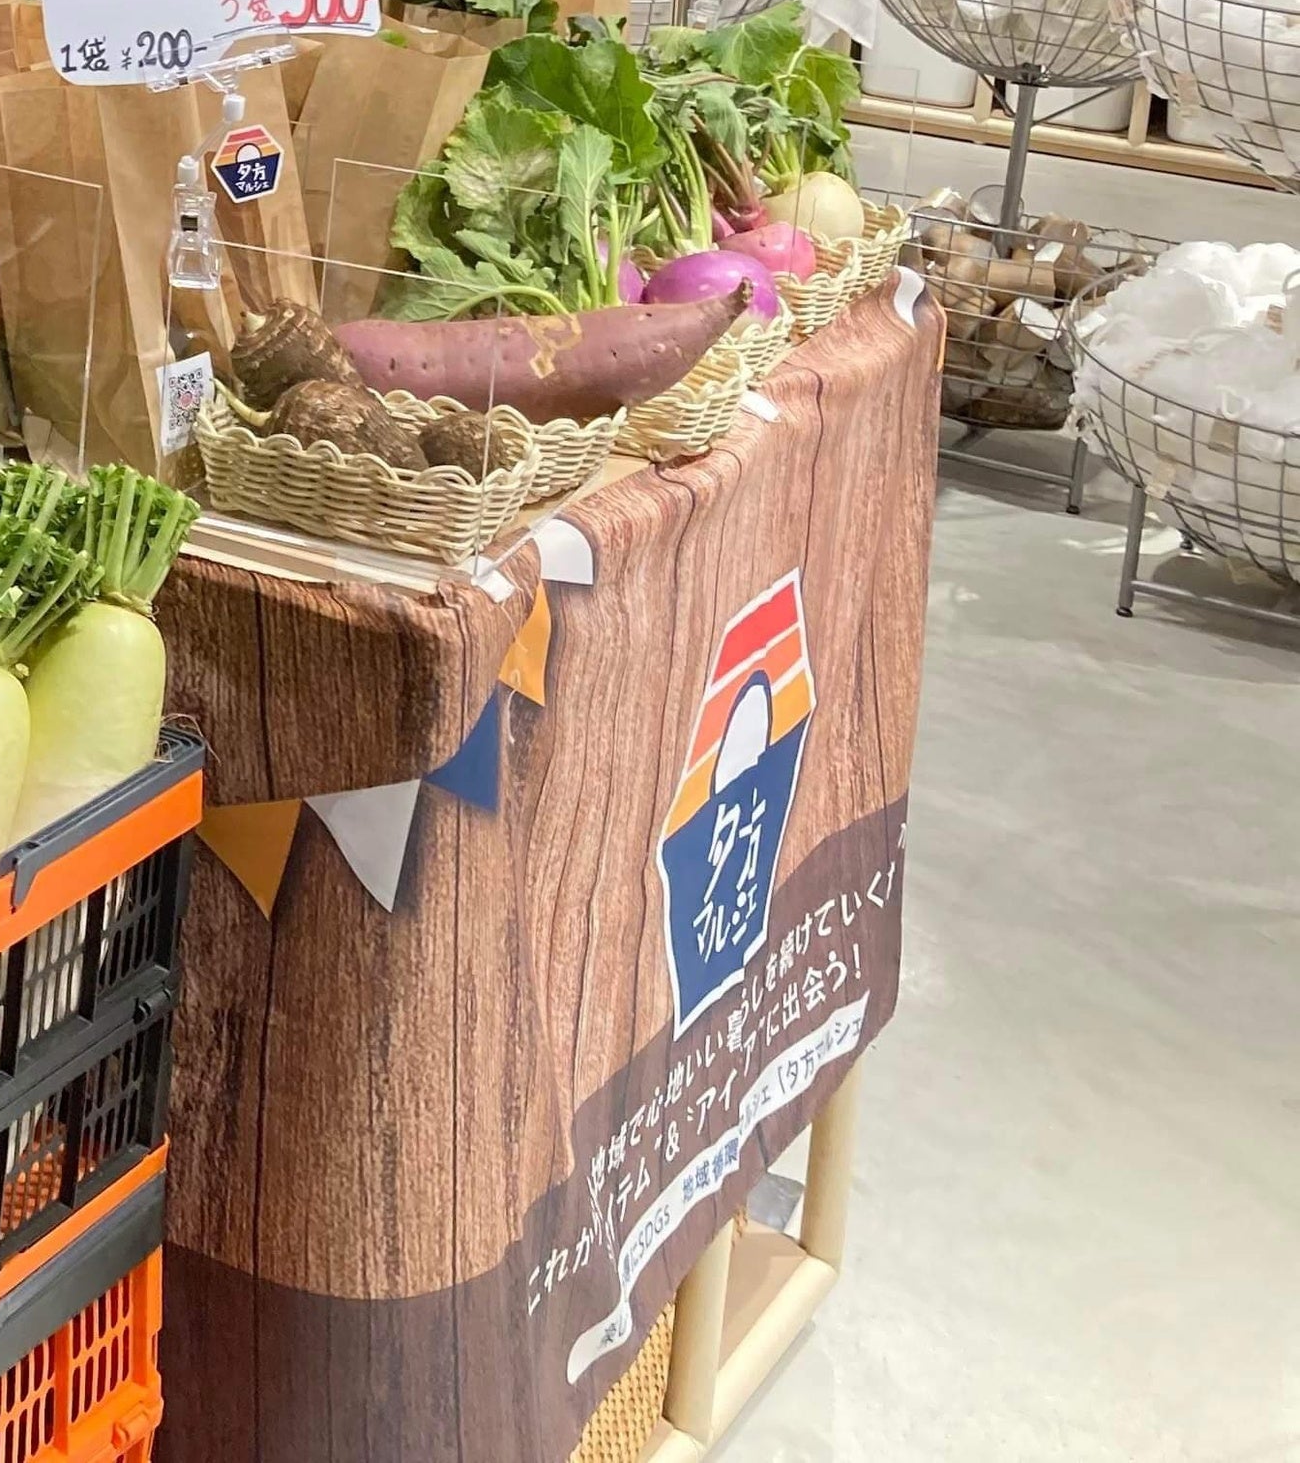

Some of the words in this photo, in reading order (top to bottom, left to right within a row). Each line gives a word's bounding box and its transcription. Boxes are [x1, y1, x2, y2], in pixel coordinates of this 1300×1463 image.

[235, 179, 271, 193] マルシェ
[237, 161, 268, 182] 夕方
[703, 784, 767, 903] 夕方
[692, 883, 758, 963] マルシェ
